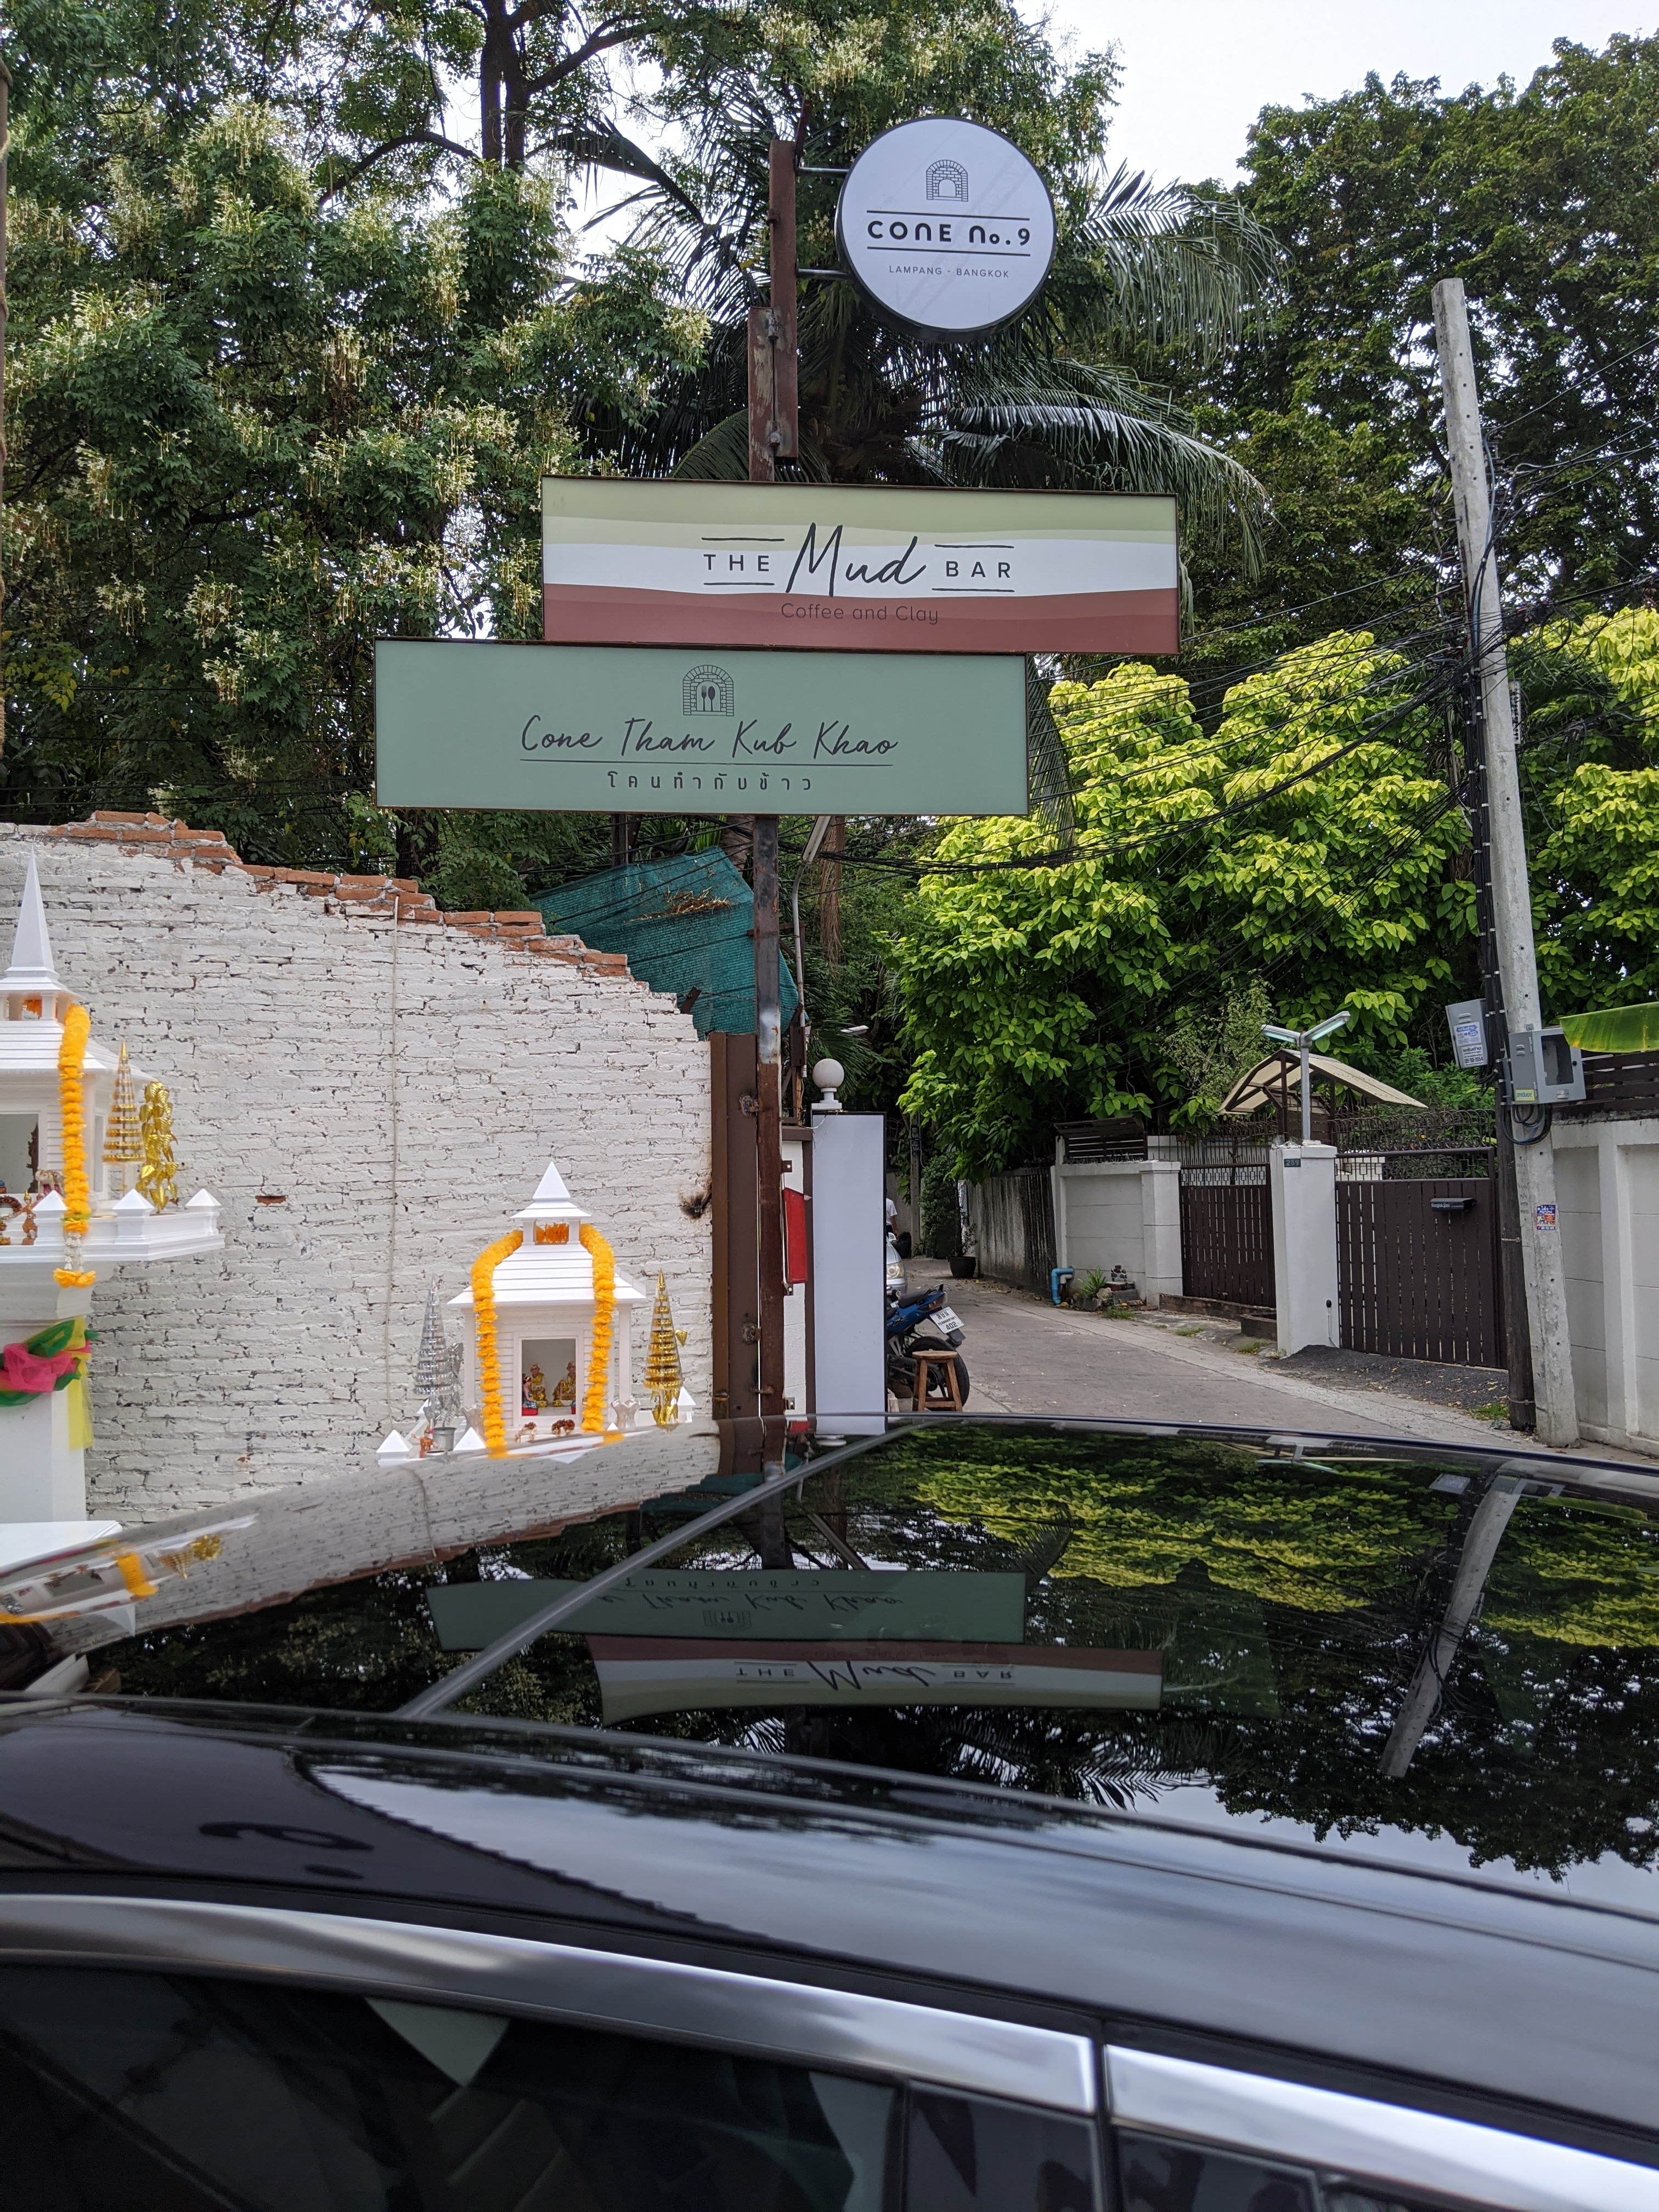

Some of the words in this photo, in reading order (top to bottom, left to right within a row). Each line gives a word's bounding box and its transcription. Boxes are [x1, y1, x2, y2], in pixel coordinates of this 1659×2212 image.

[889, 265, 942, 275] LAMPANG
[956, 267, 1009, 278] BANGKOK
[703, 554, 770, 572] THE
[785, 522, 927, 597] Mud
[945, 561, 1011, 578] BAR
[781, 602, 844, 620] Coffee
[852, 606, 887, 620] and
[895, 605, 939, 625] Clay
[521, 714, 603, 751] Cone
[621, 717, 715, 757] Tham
[732, 719, 797, 758] Kub
[813, 720, 899, 759] Khao
[607, 770, 811, 791] โคนทำกับข้าว
[945, 1321, 958, 1330] 402
